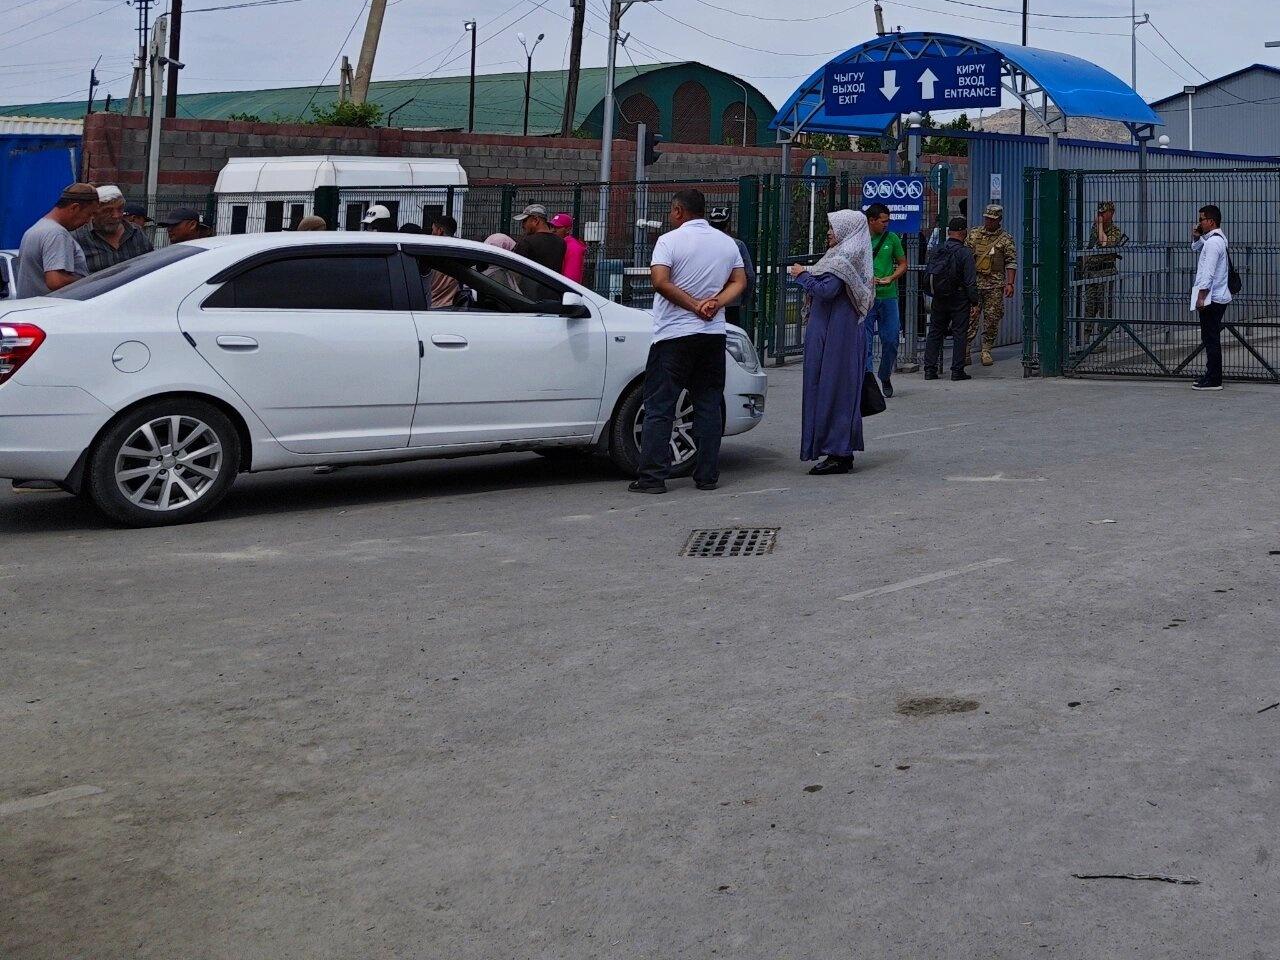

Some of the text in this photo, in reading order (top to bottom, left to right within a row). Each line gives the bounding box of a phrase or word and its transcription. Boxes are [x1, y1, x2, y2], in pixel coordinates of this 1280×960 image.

[833, 72, 865, 83] ЧЫГУУ
[958, 75, 985, 87] ВХОД
[832, 82, 866, 94] ВЫХОД
[944, 87, 997, 99] ENTRANCE
[838, 94, 859, 105] EXIT
